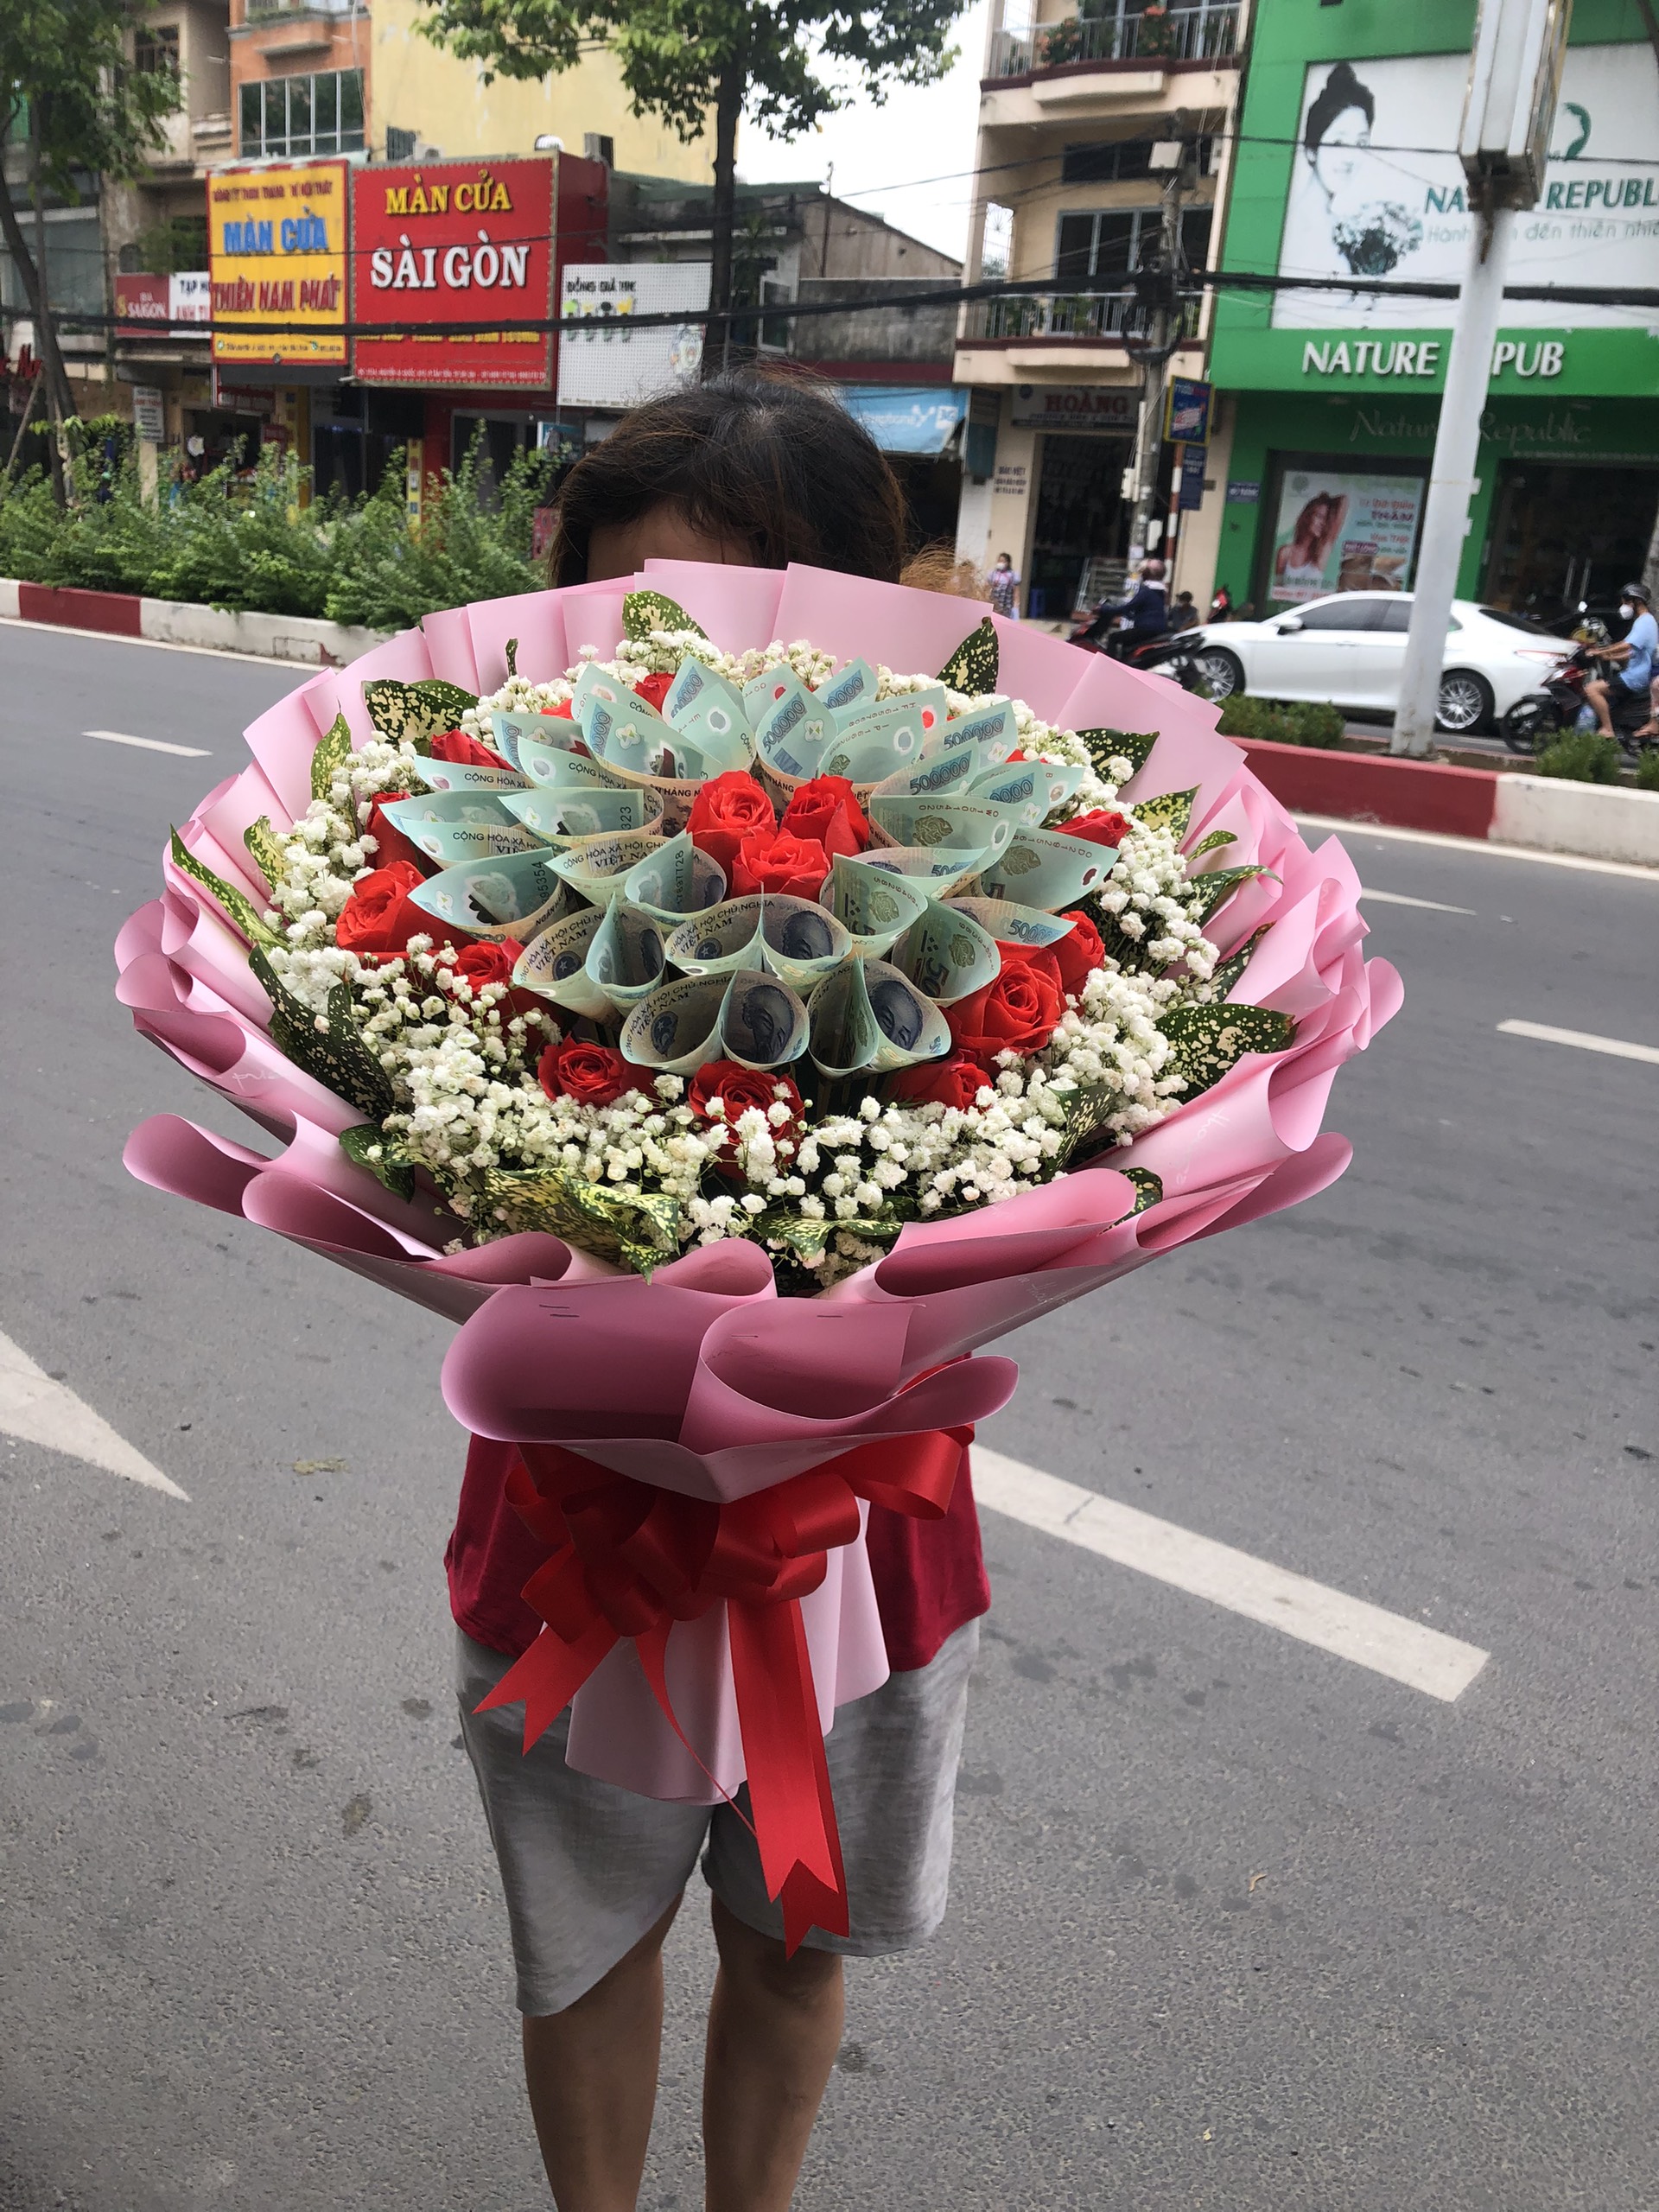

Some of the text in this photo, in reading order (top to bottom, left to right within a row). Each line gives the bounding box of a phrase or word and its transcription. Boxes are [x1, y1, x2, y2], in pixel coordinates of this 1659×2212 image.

[385, 169, 512, 215] MÀN CỬA
[223, 213, 274, 254] MÀN
[371, 228, 531, 289] SÀI GÒN
[259, 280, 296, 312] NAM
[1301, 340, 1566, 378] NATURE PUB
[1349, 410, 1439, 442] Natur
[762, 699, 807, 753] 500000
[944, 717, 1004, 750] 500000
[464, 772, 494, 783] CỘNG
[497, 776, 516, 786] HÒA
[569, 762, 597, 776] CỘNG
[598, 772, 614, 785] HÒA
[910, 756, 970, 795] 500000
[664, 786, 692, 798] HÀNG
[453, 831, 485, 842] CỘNG
[487, 834, 510, 843] HÒA
[563, 854, 584, 869] CỘNG
[586, 849, 606, 860] HÒA
[608, 843, 623, 854] XÃ
[625, 841, 643, 850] HỘI
[594, 854, 626, 868] VIỆT
[700, 915, 715, 928] HỘI
[717, 904, 739, 918] CHỦ
[741, 899, 775, 911] NGHĨA
[705, 917, 734, 935] NAM
[527, 950, 540, 968] HÒA
[551, 927, 568, 943] HỘI
[569, 915, 591, 931] CHỦ
[559, 929, 588, 950] NAM
[653, 991, 671, 1005] HỘI
[672, 981, 696, 994] CHỦ
[658, 992, 690, 1011] NAM
